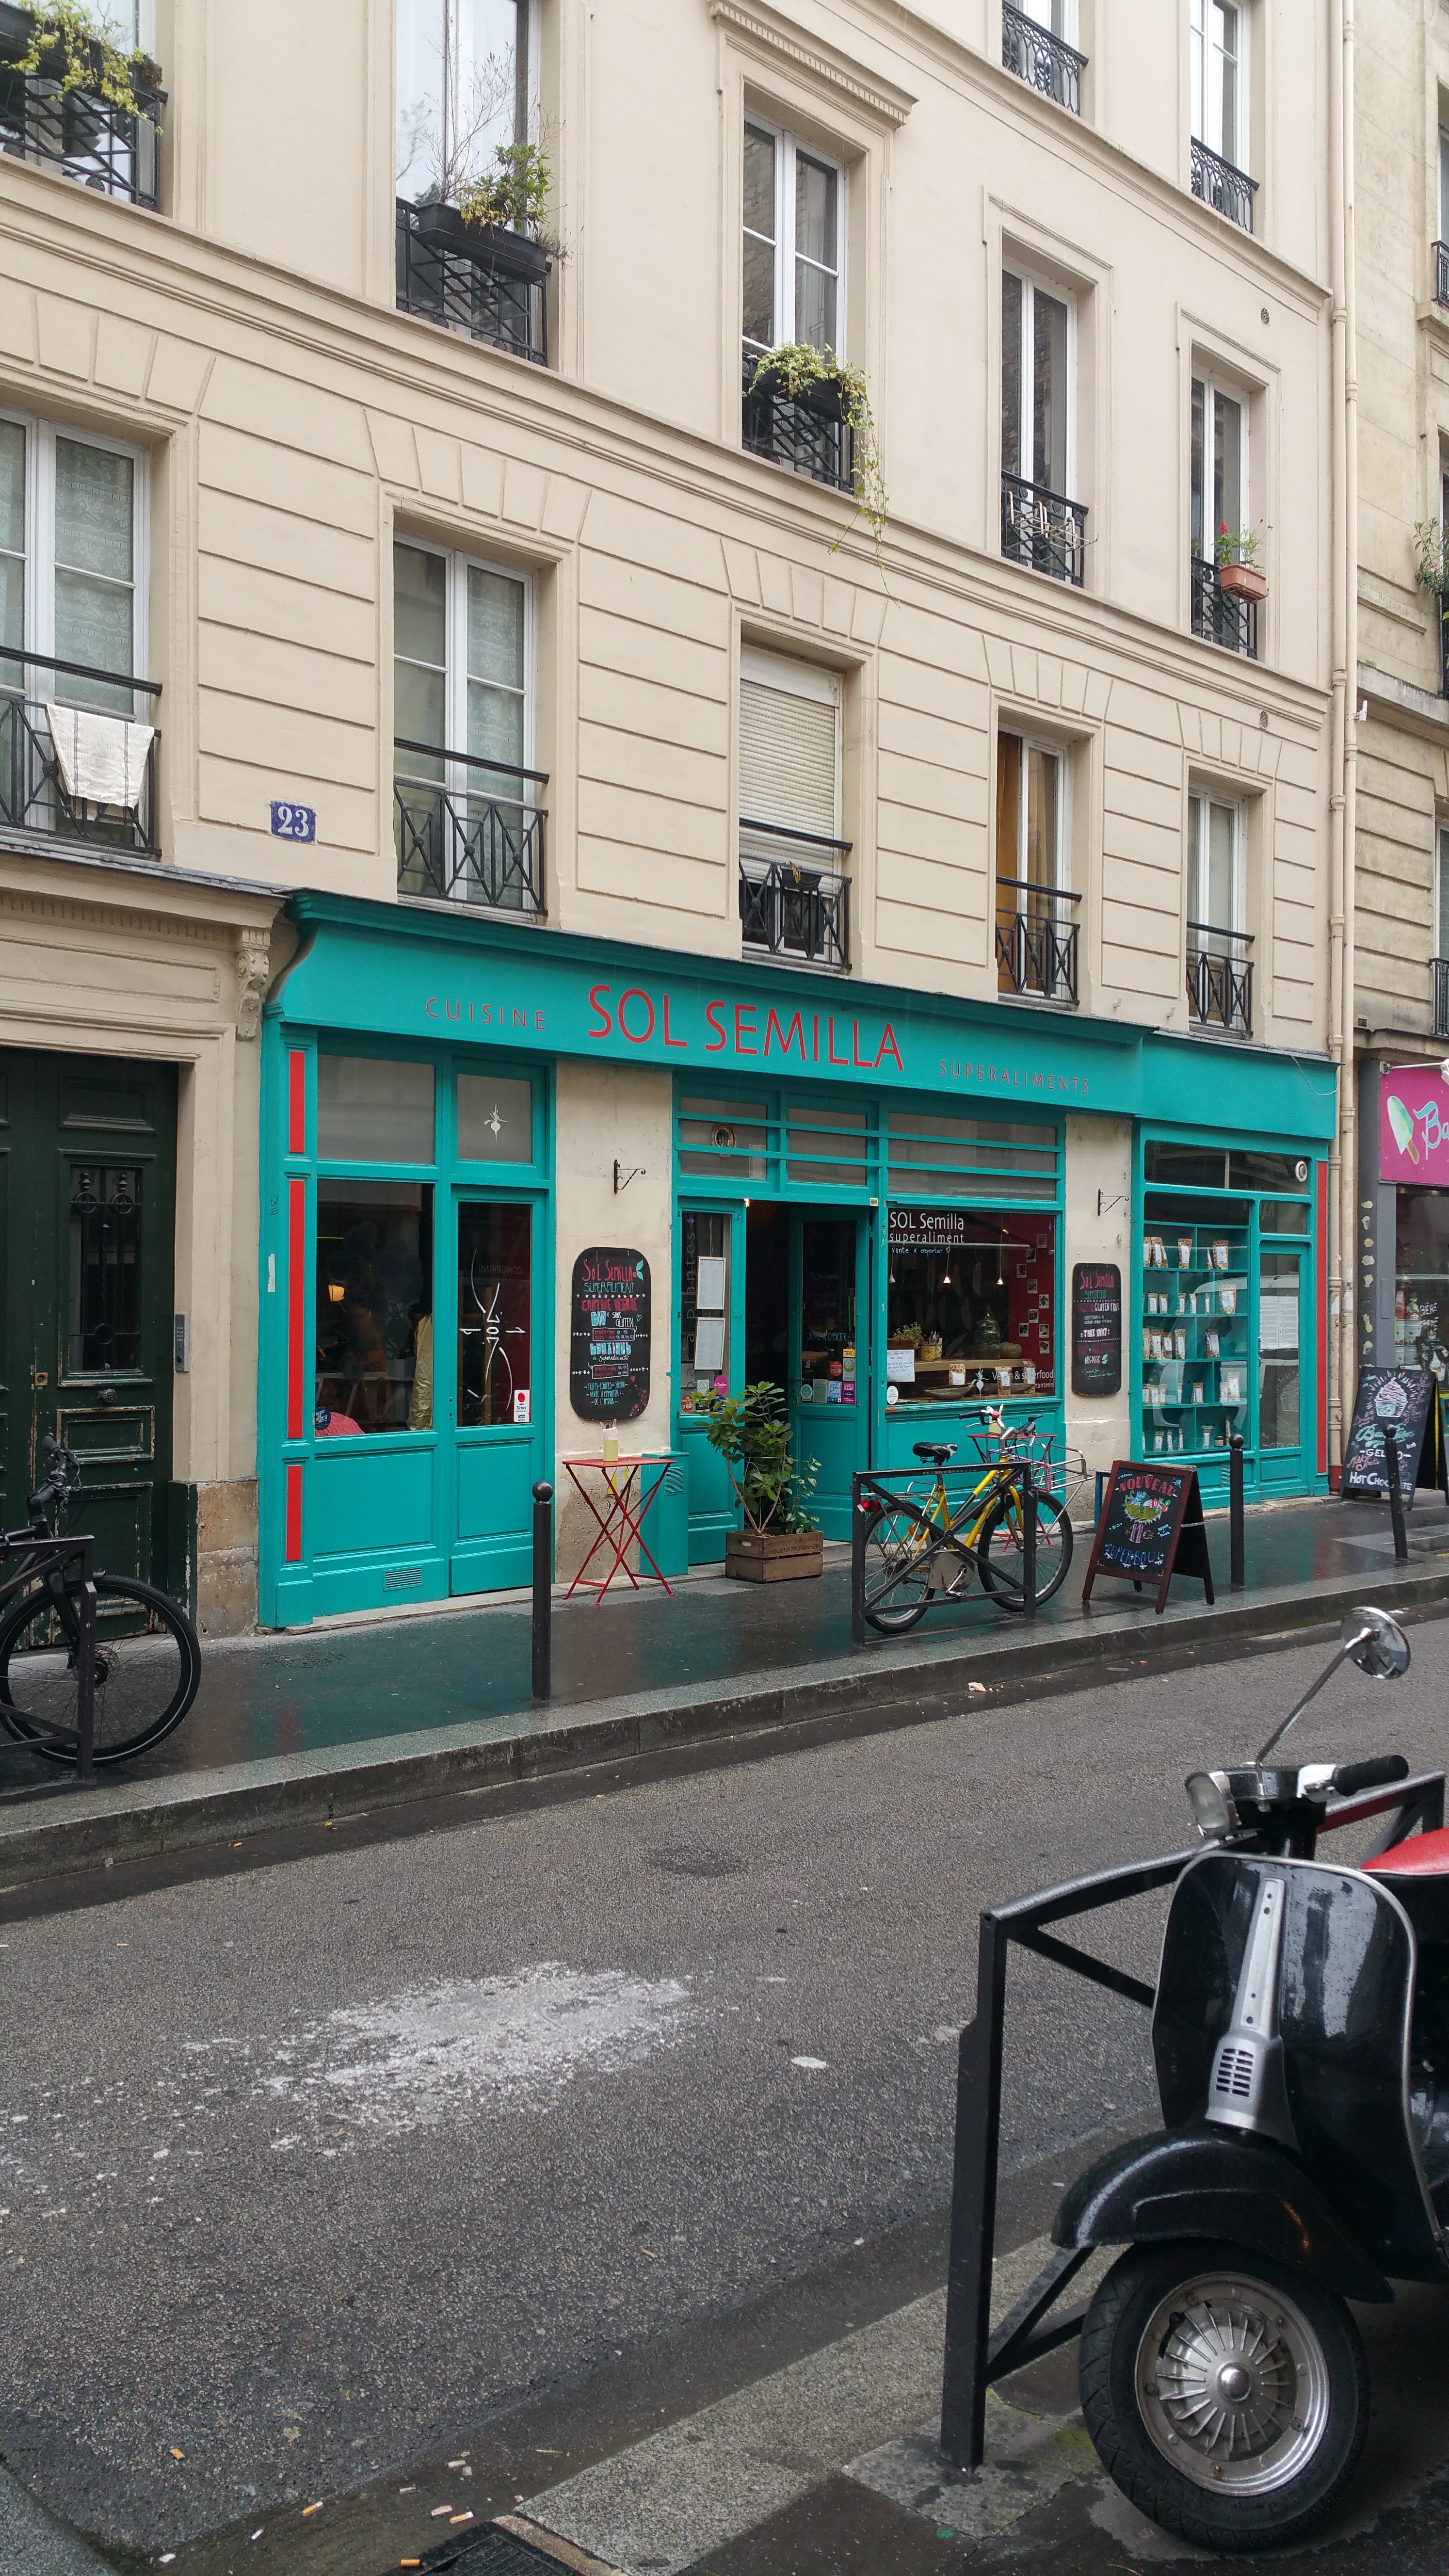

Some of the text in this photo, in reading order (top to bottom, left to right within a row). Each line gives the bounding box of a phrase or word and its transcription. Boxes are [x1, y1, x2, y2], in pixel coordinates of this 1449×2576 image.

[278, 806, 309, 837] 23
[426, 998, 546, 1031] CUISINE
[588, 984, 904, 1072] SOL SEMILLA
[939, 1059, 1090, 1095] SUPERALIMENTS
[890, 1211, 964, 1230] SOL Semilla
[889, 1231, 965, 1245] superaliment
[584, 1282, 635, 1293] SUPERALIMENT
[581, 1298, 612, 1311] CANTINE
[1095, 1303, 1110, 1312] GLUTEN
[615, 1318, 634, 1328] GLUTEN
[1083, 1329, 1095, 1338] TAKE
[992, 1371, 1013, 1381] Ven
[1015, 1370, 1021, 1380] &
[1366, 1448, 1403, 1460] GELO
[1119, 1475, 1176, 1497] NOUVEAU
[1106, 1543, 1161, 1566] SUPER BOWL
